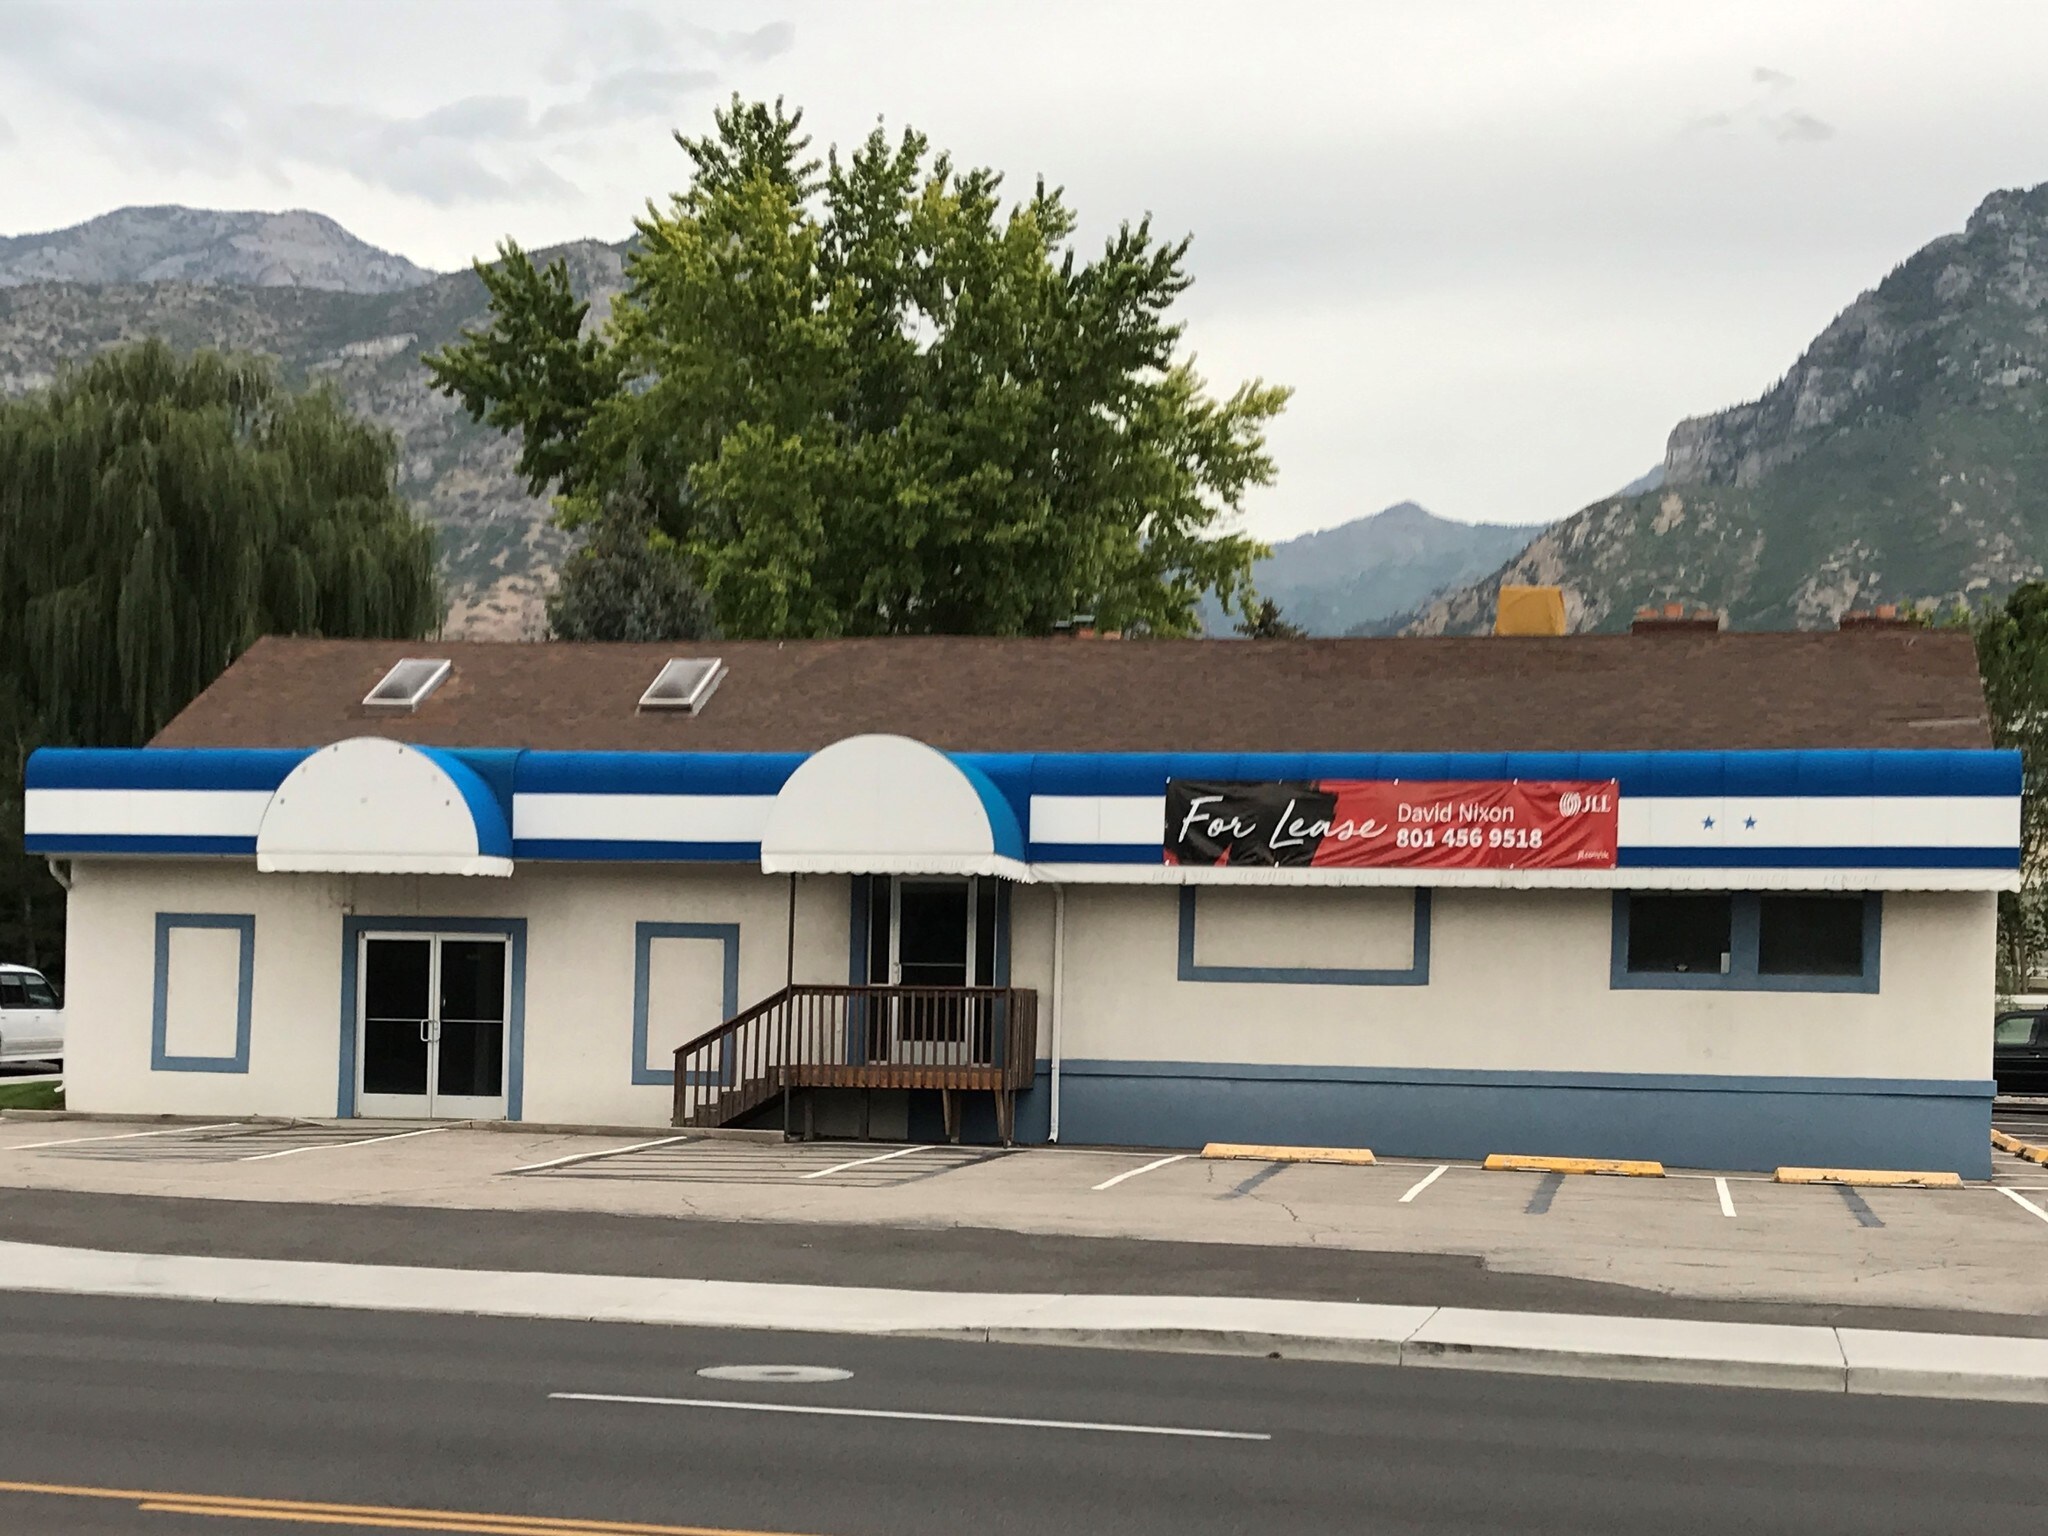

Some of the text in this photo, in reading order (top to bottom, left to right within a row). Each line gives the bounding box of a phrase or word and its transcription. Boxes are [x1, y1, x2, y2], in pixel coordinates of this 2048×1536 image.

[1397, 801, 1515, 823] David Nixon
[1581, 794, 1611, 813] JLL
[1178, 795, 1388, 849] For Lease
[1396, 827, 1543, 849] 801 456 9518
